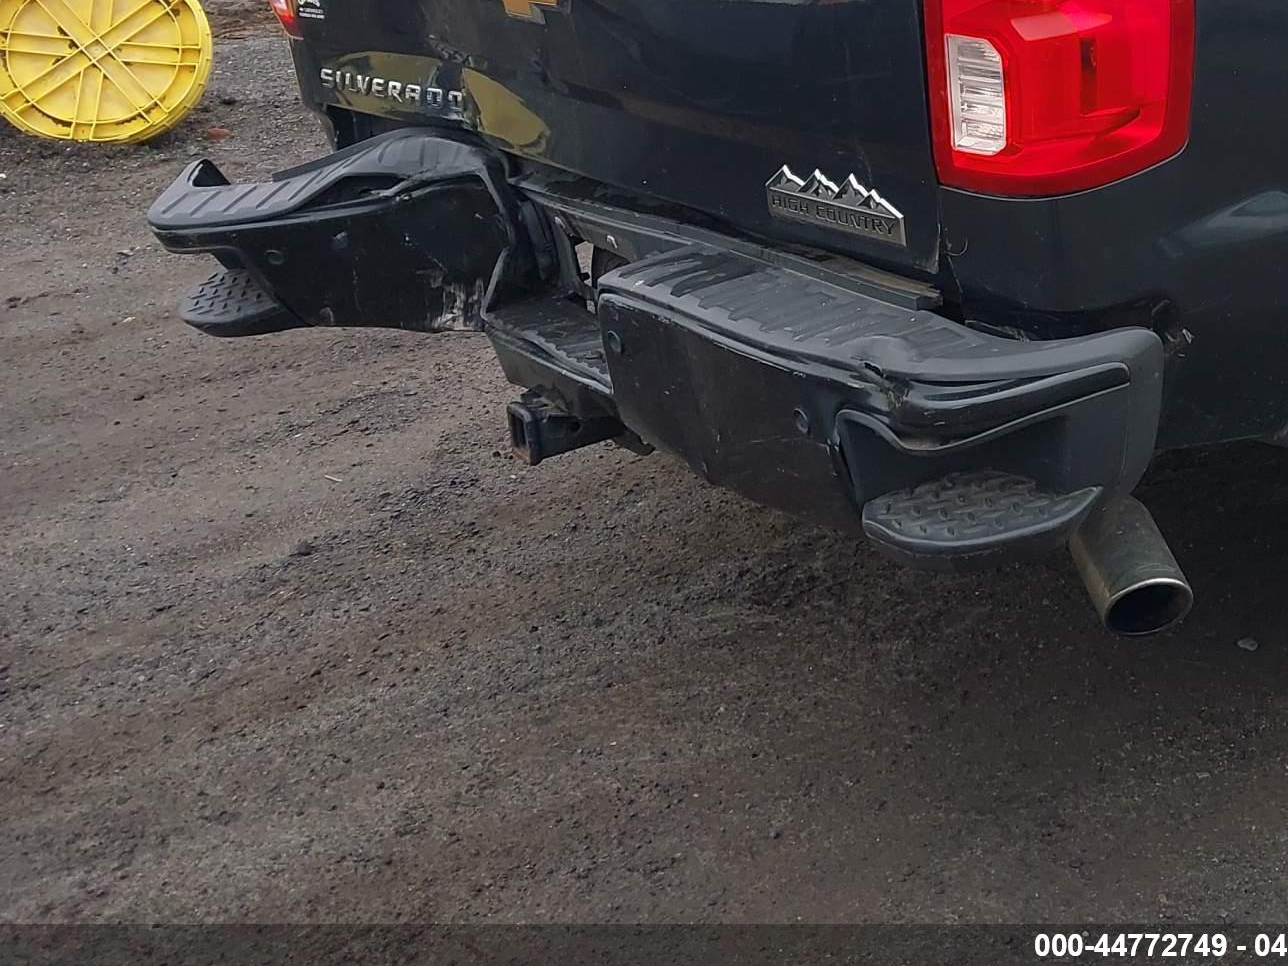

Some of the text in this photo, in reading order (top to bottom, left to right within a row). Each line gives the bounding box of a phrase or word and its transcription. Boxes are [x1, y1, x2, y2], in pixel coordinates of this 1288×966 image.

[320, 68, 465, 110] SILVERADO
[771, 194, 896, 237] HIGH COUNTRY
